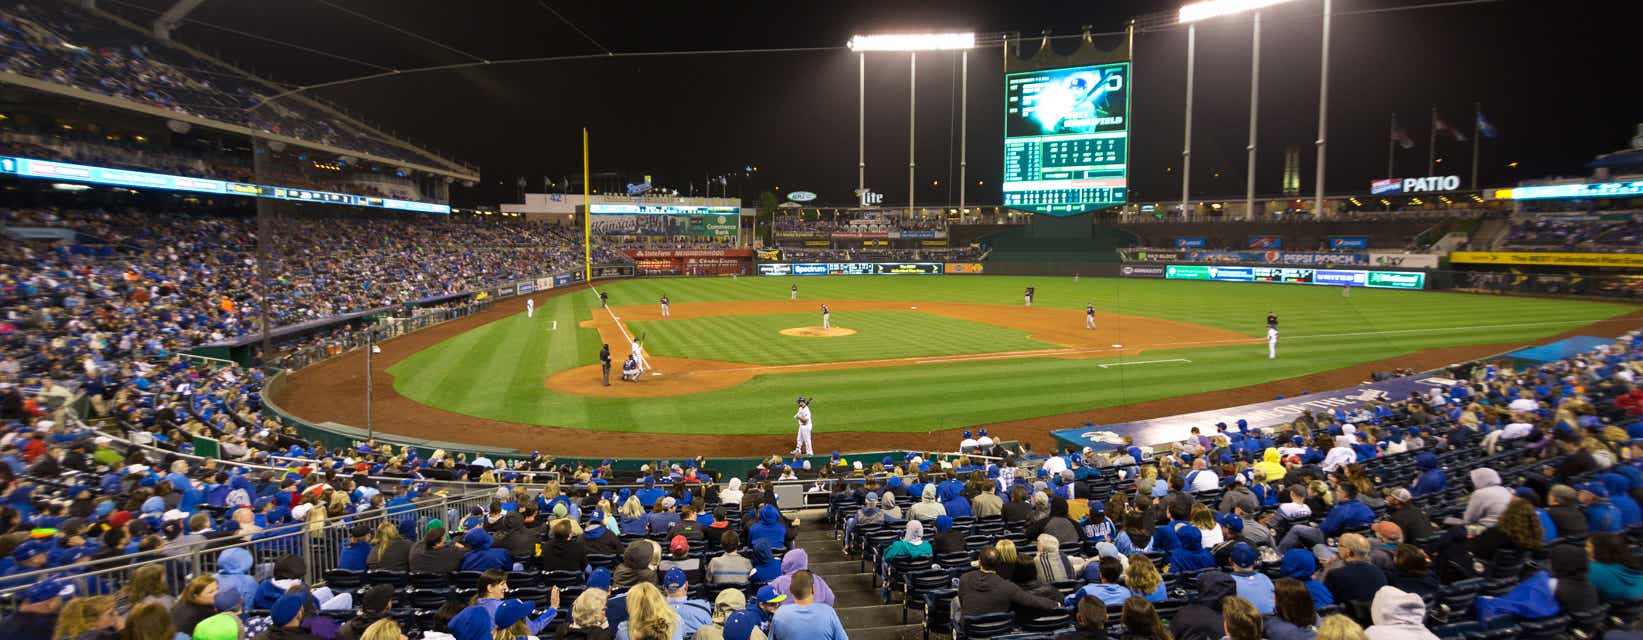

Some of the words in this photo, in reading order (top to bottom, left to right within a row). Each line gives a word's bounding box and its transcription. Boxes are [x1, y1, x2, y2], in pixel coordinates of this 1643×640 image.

[1403, 176, 1460, 193] PATIO
[856, 188, 884, 206] Lite
[1283, 253, 1314, 265] PEPSI
[1315, 254, 1355, 266] PORCH
[795, 265, 824, 274] Spectrum
